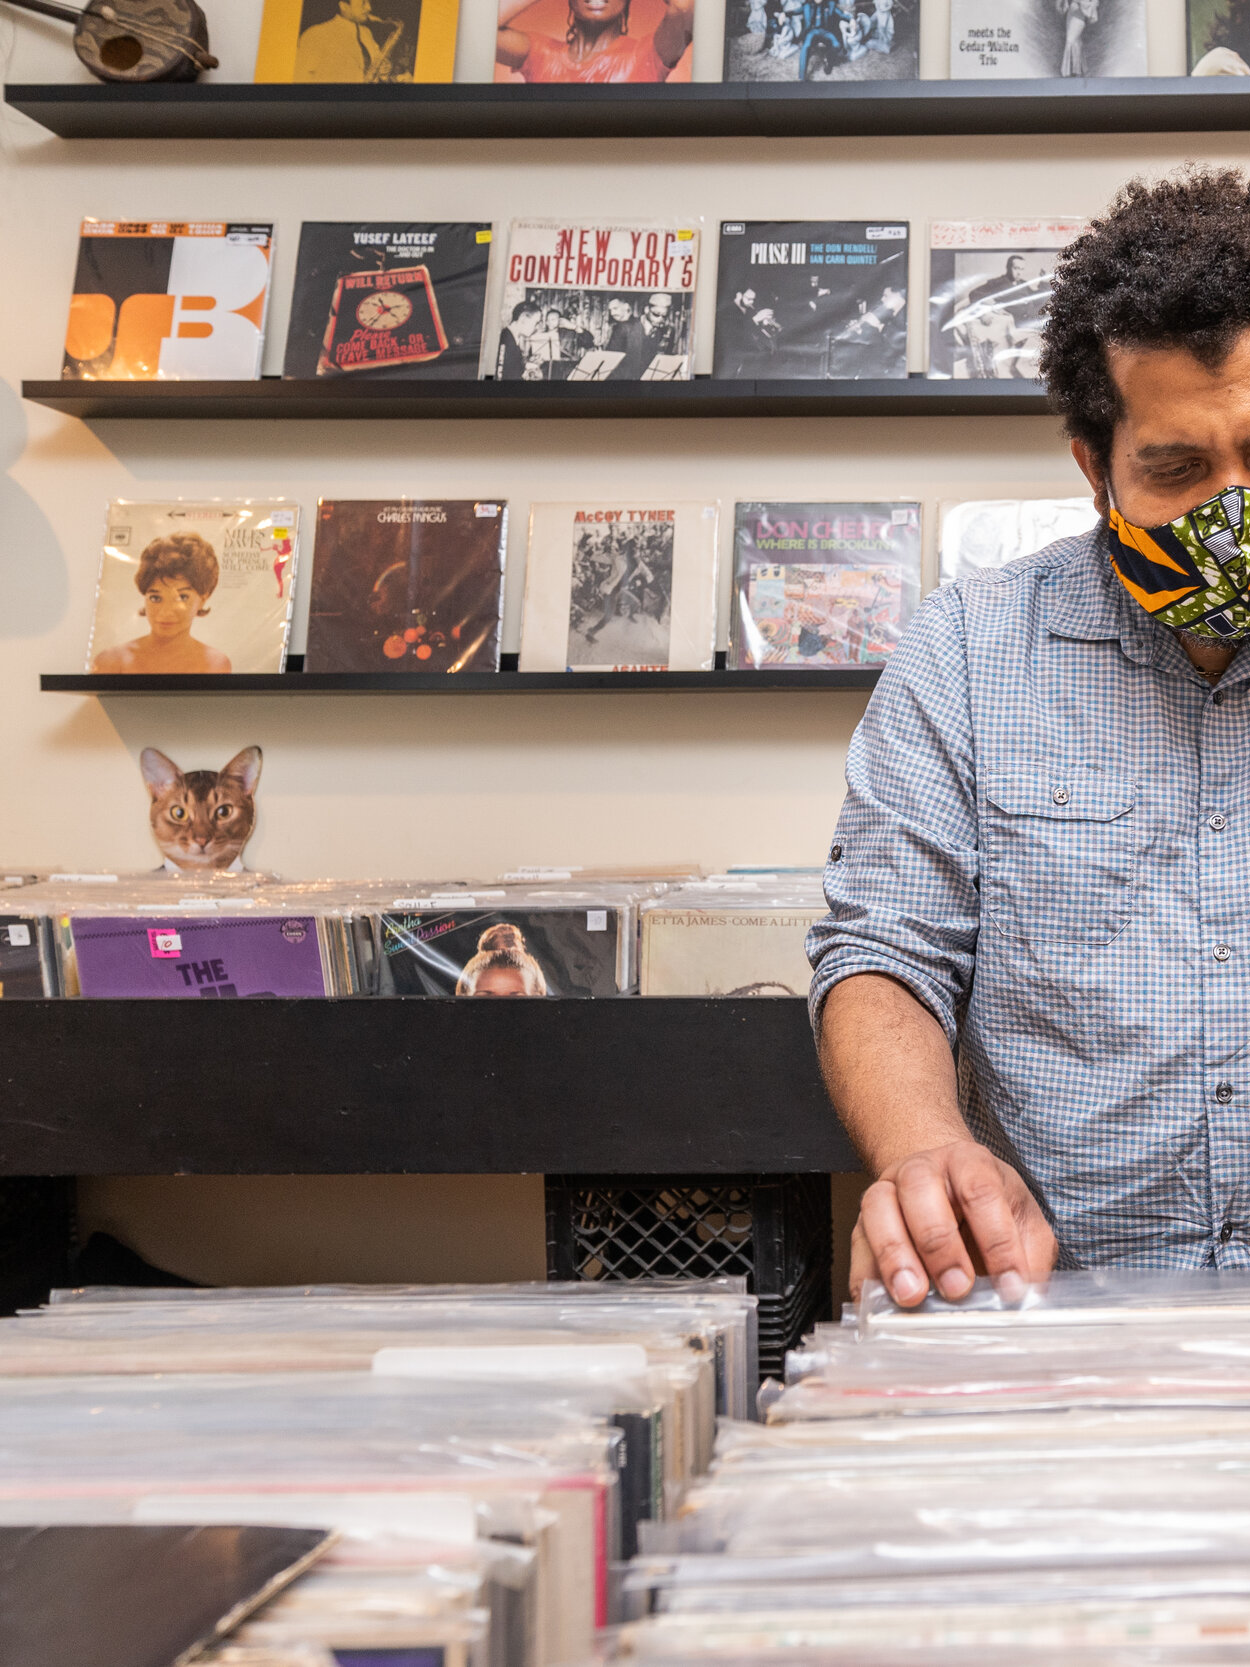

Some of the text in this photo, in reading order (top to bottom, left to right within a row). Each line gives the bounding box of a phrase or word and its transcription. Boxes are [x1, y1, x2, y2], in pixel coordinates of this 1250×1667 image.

[968, 28, 1011, 38] meets the
[959, 41, 985, 52] Cedar
[979, 54, 997, 66] Trio
[353, 232, 437, 245] YUSEF LATEEF
[560, 229, 612, 260] NEW
[631, 232, 694, 263] YOR
[810, 243, 824, 253] THE
[826, 243, 841, 253] DON
[751, 242, 807, 265] PHASE III
[810, 255, 877, 264] IAN CARR QUINTET
[509, 254, 694, 288] CONTEMPORARY 5
[345, 271, 424, 289] WILL RETURN
[336, 341, 367, 355] COME
[369, 336, 398, 350] BACK
[377, 512, 447, 523] CHARLES MINGUS
[574, 510, 675, 523] McCOY TYNER
[224, 527, 265, 539] MILES
[756, 521, 809, 539] DON
[222, 538, 261, 549] DAVIS
[756, 538, 805, 550] WHERE
[808, 539, 817, 549] IS
[652, 916, 815, 927] ETTA JAMES COME A LITTL
[175, 959, 229, 987] THE
